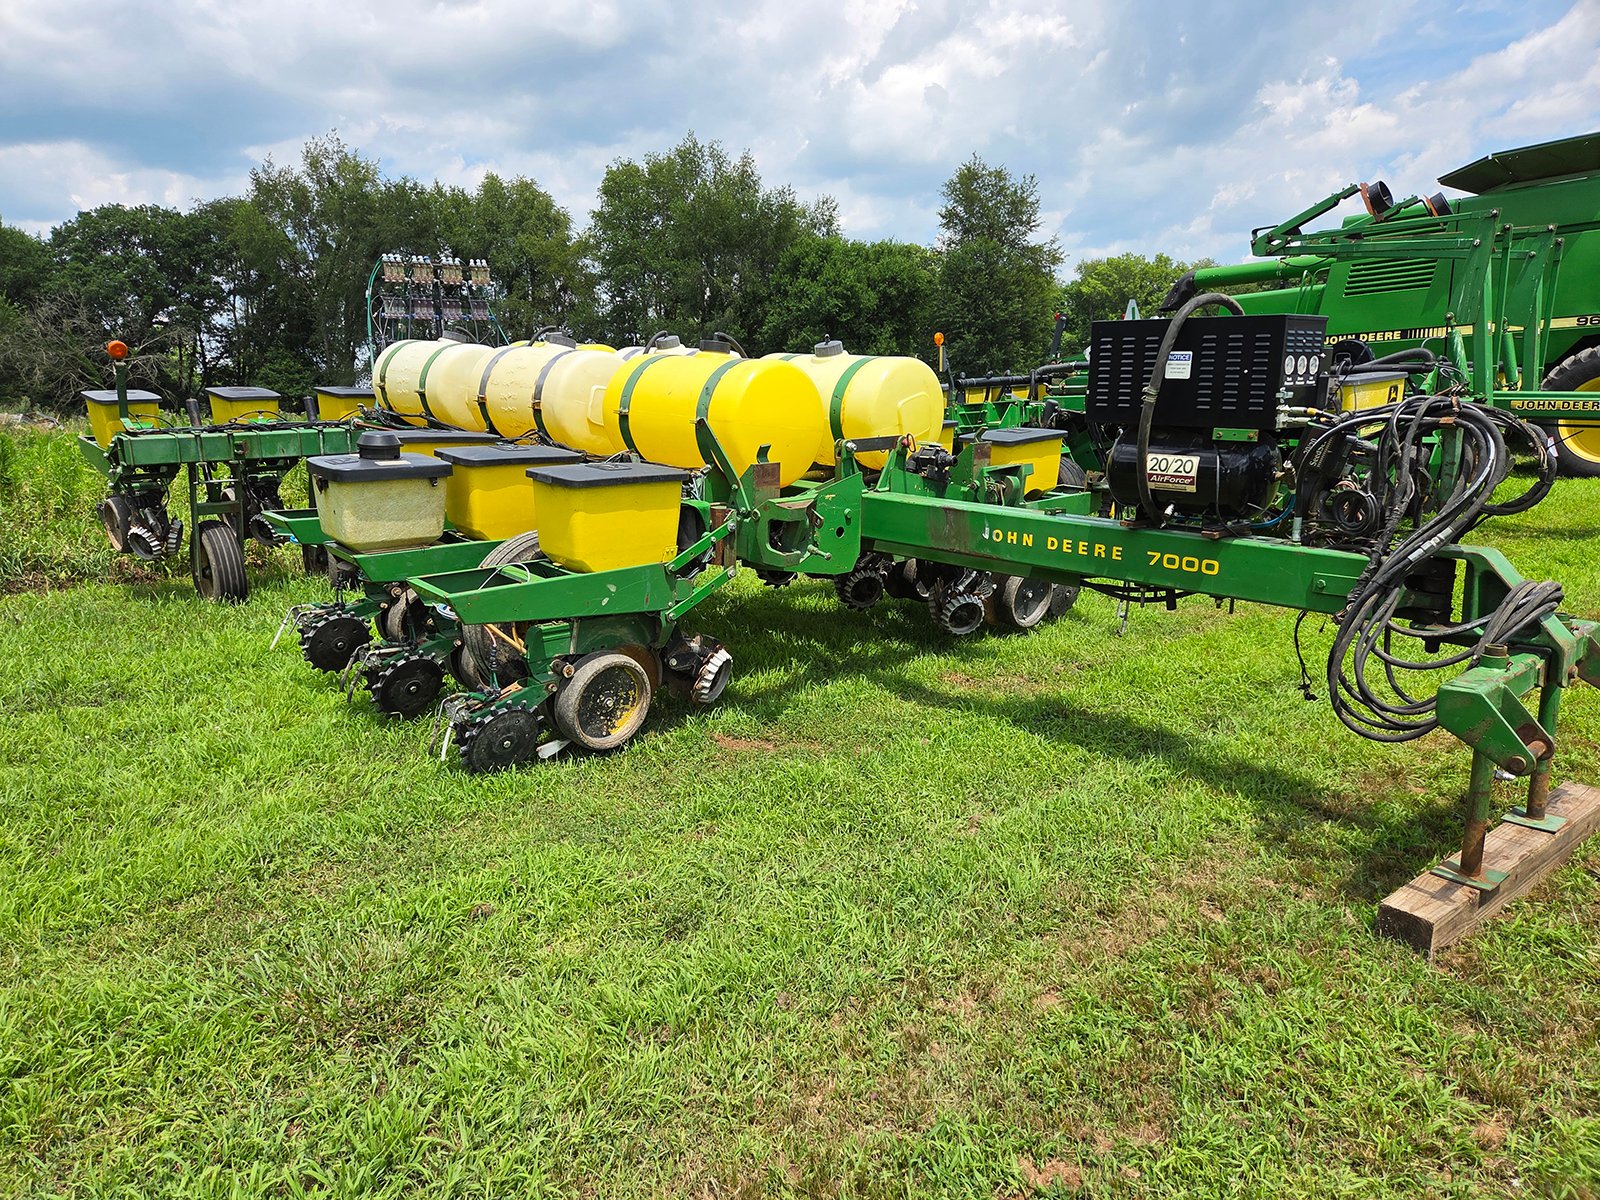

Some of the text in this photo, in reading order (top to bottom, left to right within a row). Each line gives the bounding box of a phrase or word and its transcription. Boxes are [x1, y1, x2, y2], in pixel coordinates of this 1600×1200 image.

[1323, 331, 1401, 345] JOHN DEERE
[1517, 401, 1556, 410] JOHN
[1149, 457, 1194, 474] 20/20
[982, 527, 1220, 576] JOHN DEERE 7000
